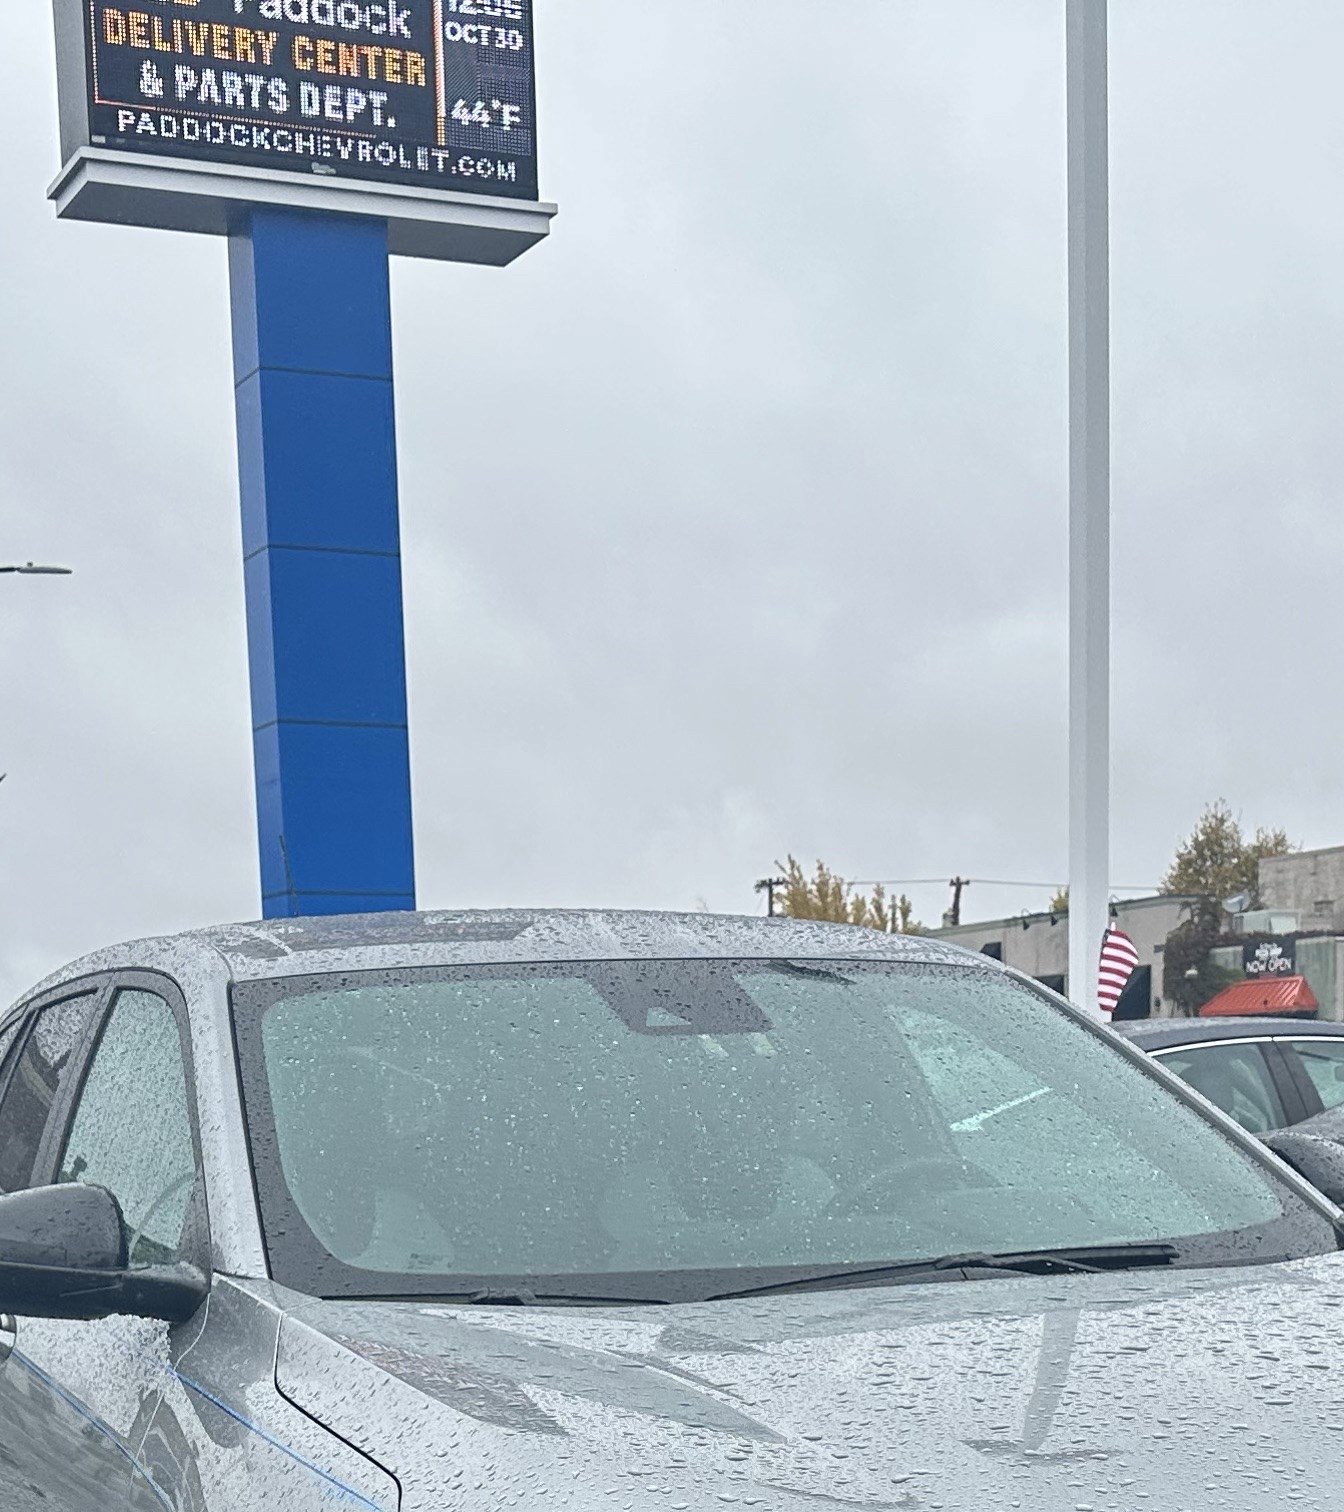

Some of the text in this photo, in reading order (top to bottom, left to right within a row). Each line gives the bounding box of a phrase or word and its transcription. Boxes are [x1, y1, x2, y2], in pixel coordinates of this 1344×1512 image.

[102, 8, 426, 87] DELIVERY CENTER
[444, 21, 523, 51] OCT 30
[140, 59, 396, 128] & PARTS DEPT.
[117, 109, 517, 182] PADDOCKCHEVROLET.COM
[1267, 957, 1292, 973] OPEN
